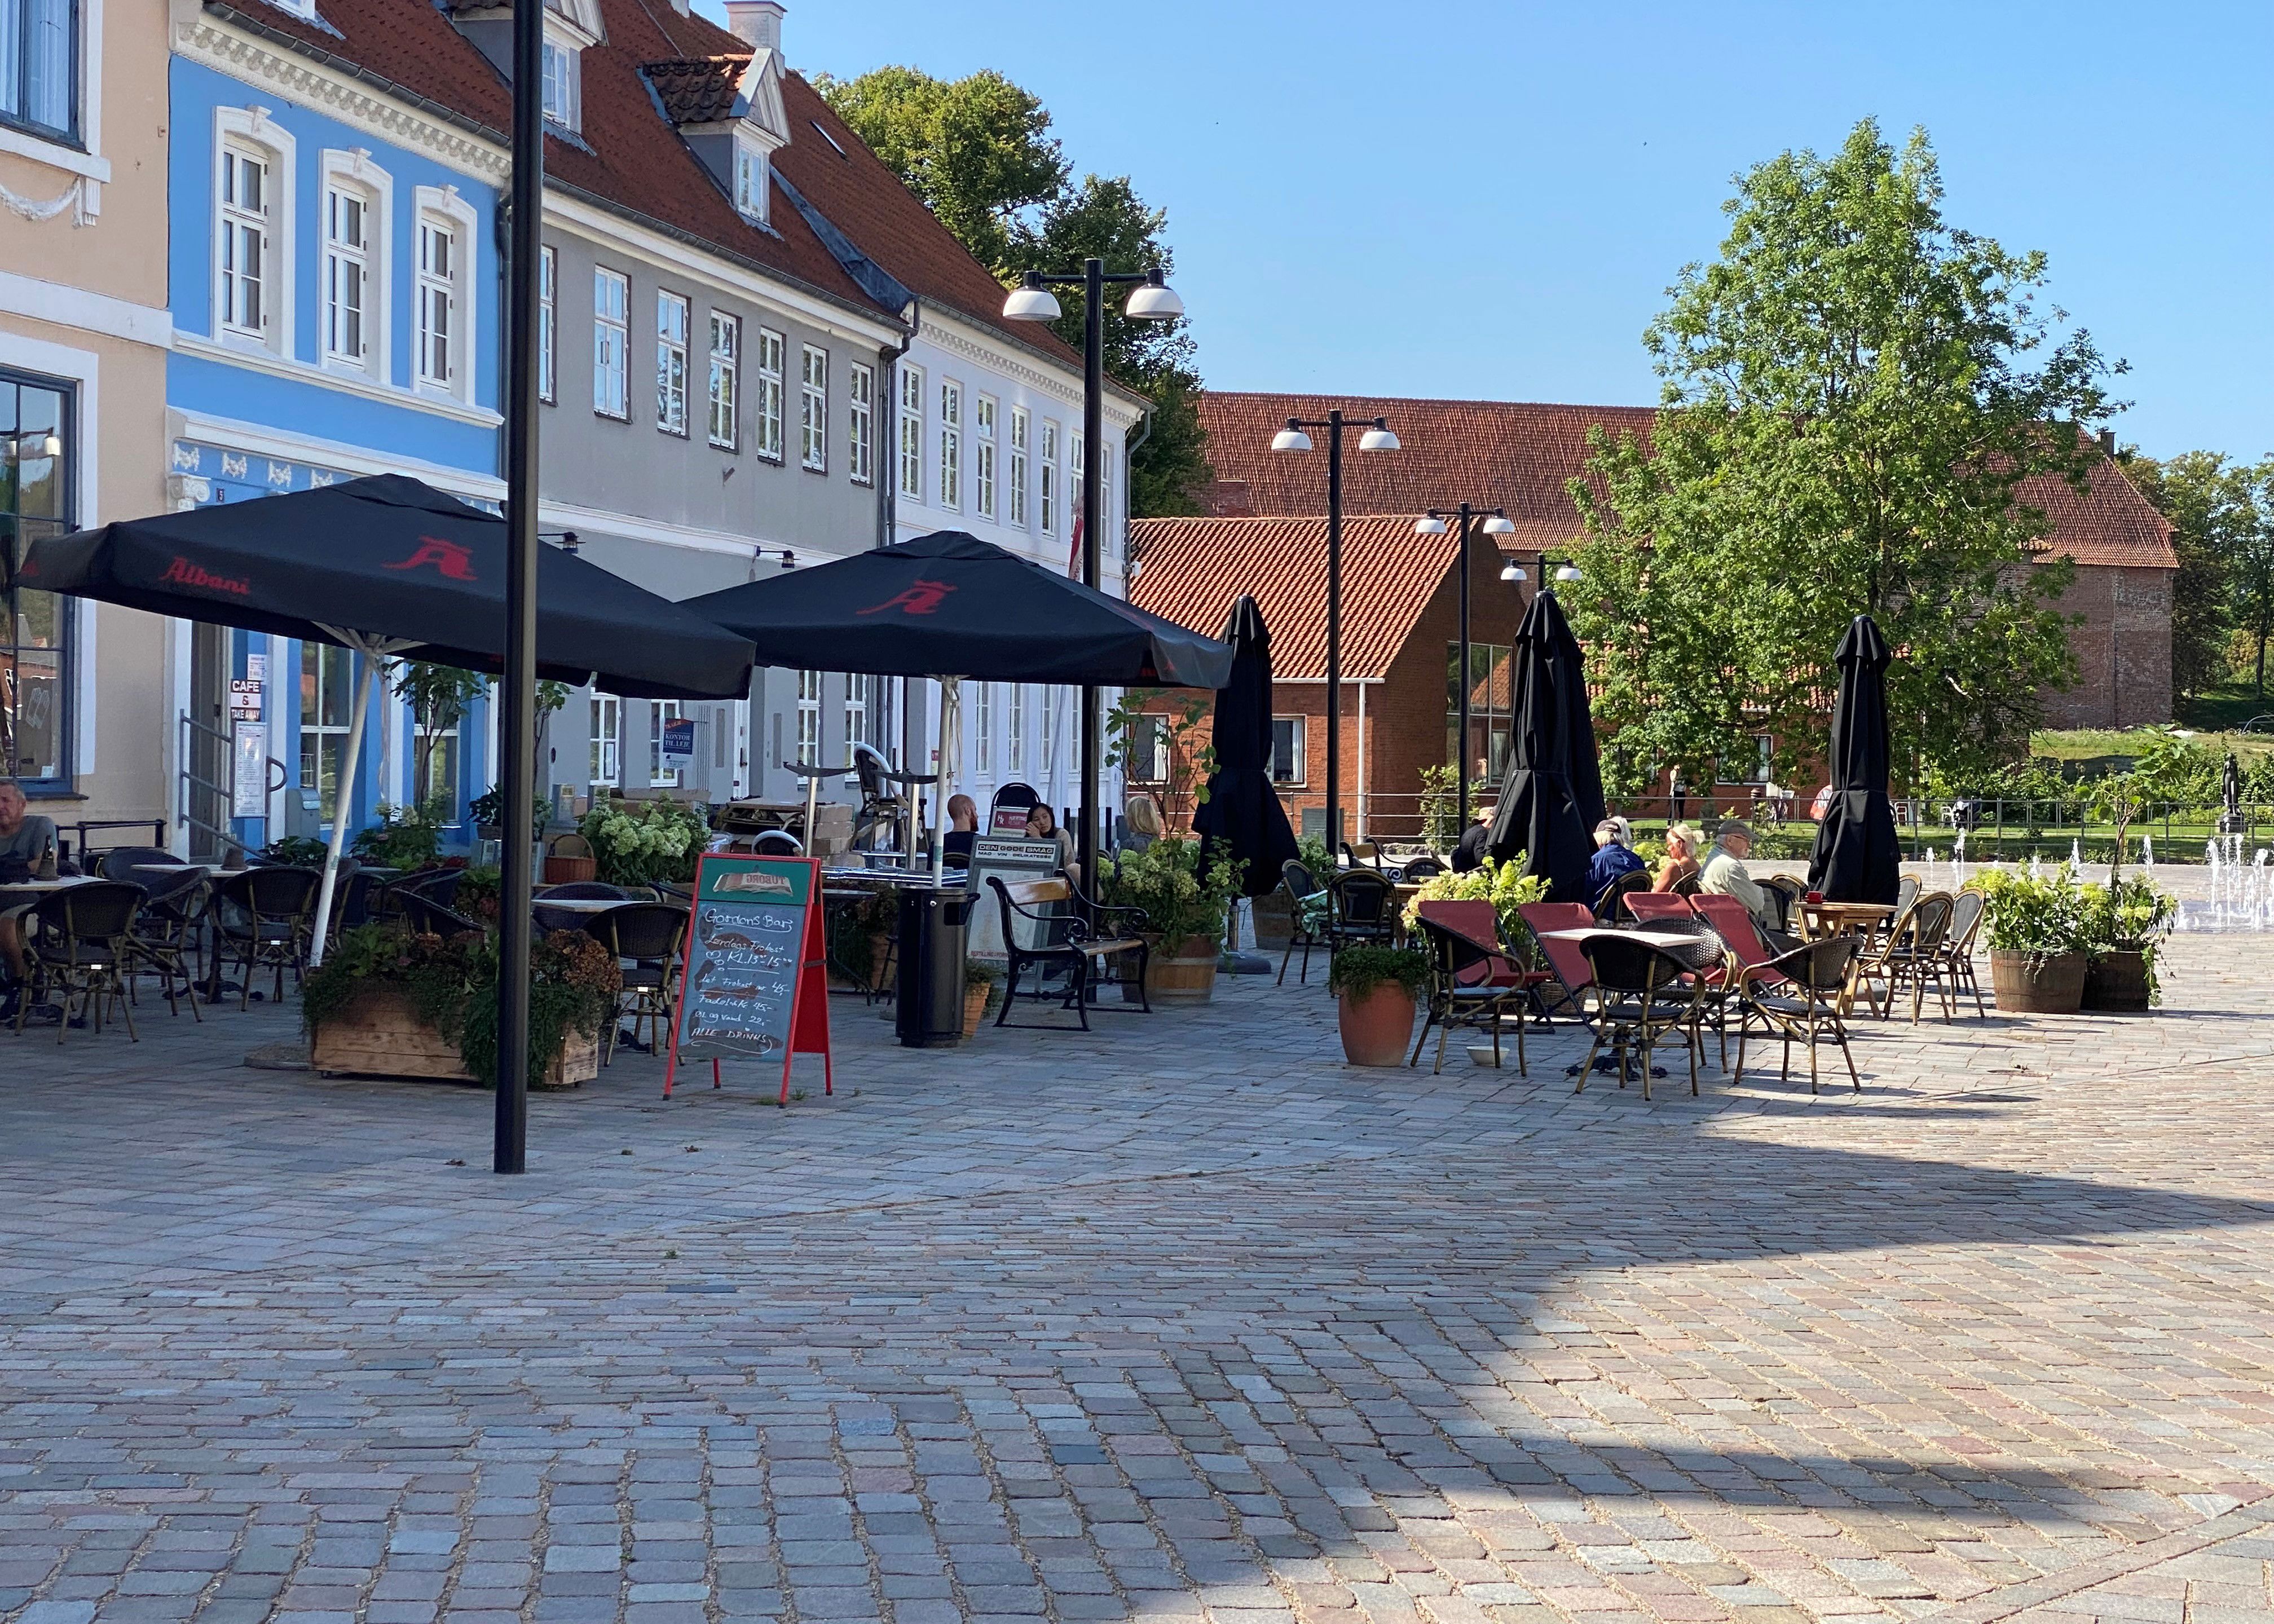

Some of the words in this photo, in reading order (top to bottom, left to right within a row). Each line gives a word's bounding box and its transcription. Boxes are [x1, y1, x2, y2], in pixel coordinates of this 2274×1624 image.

[159, 555, 250, 595] Albani
[232, 680, 259, 692] CAFE
[242, 695, 249, 705] &
[691, 1027, 718, 1036] ALLE
